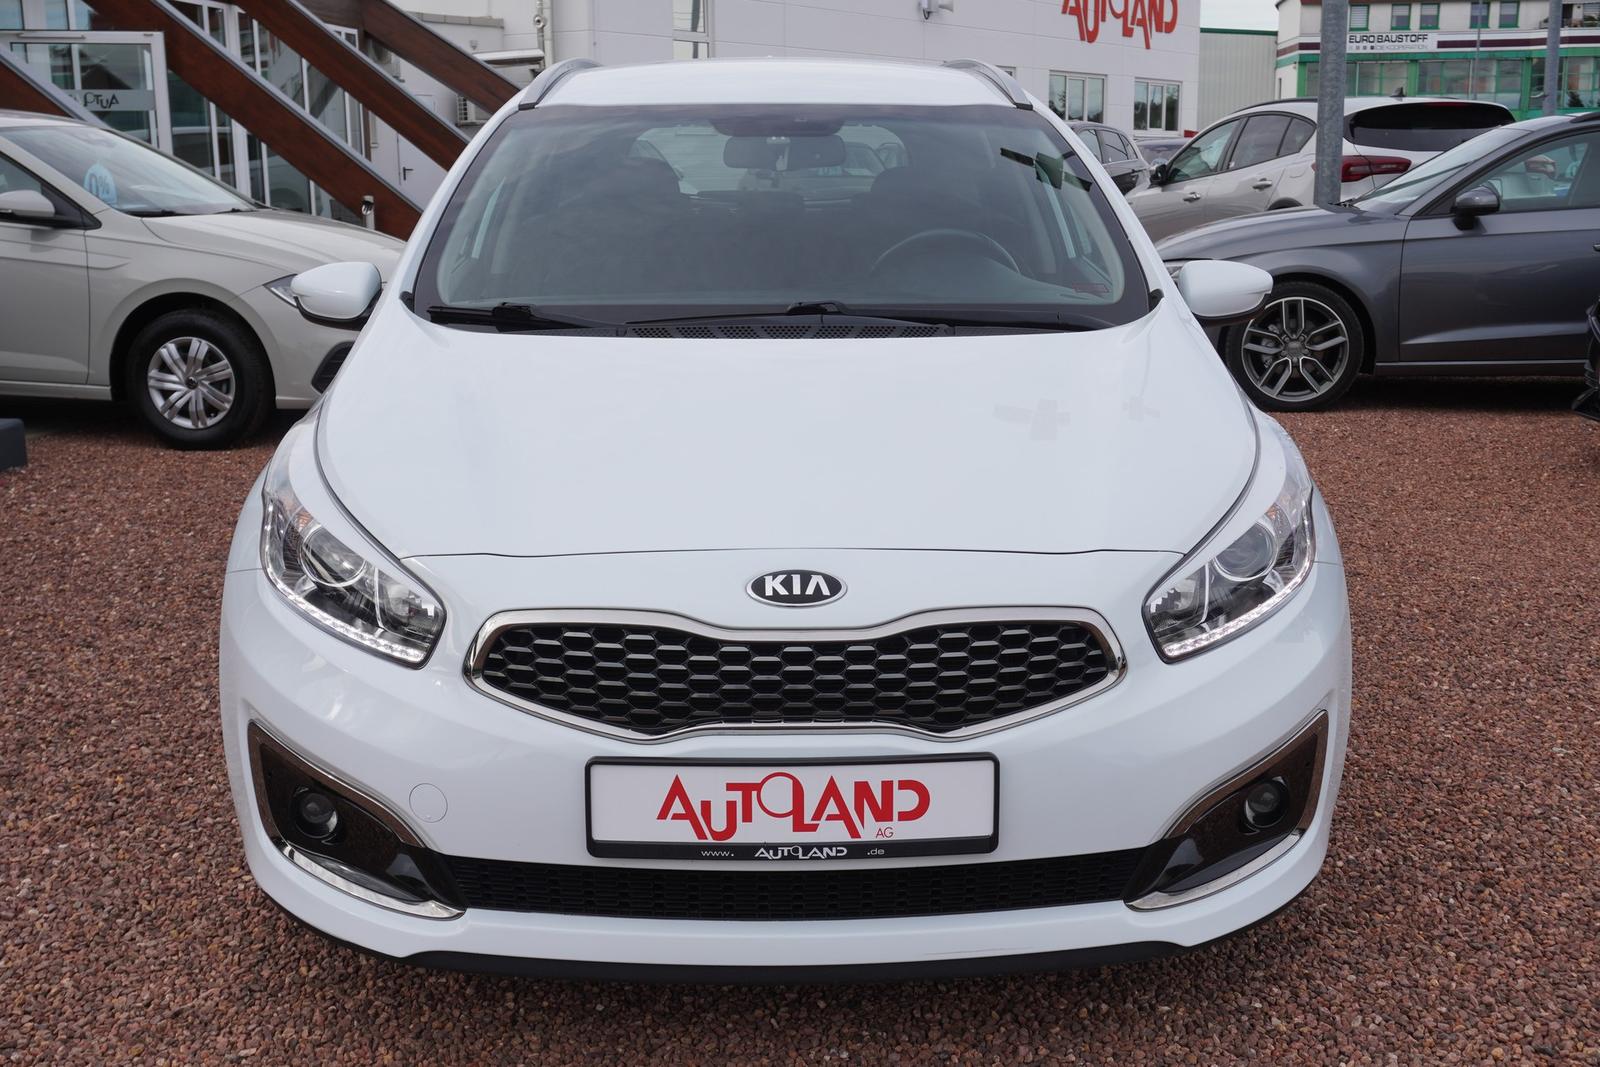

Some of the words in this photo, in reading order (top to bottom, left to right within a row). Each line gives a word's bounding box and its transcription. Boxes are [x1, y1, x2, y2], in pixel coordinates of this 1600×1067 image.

[1348, 35, 1375, 44] EURO
[1376, 34, 1428, 43] BAUSTOFF
[764, 574, 831, 596] KIA
[656, 772, 931, 841] AUTOLAND
[875, 826, 895, 839] AG
[755, 846, 848, 860] AUTOLAND
[866, 847, 885, 856] .de
